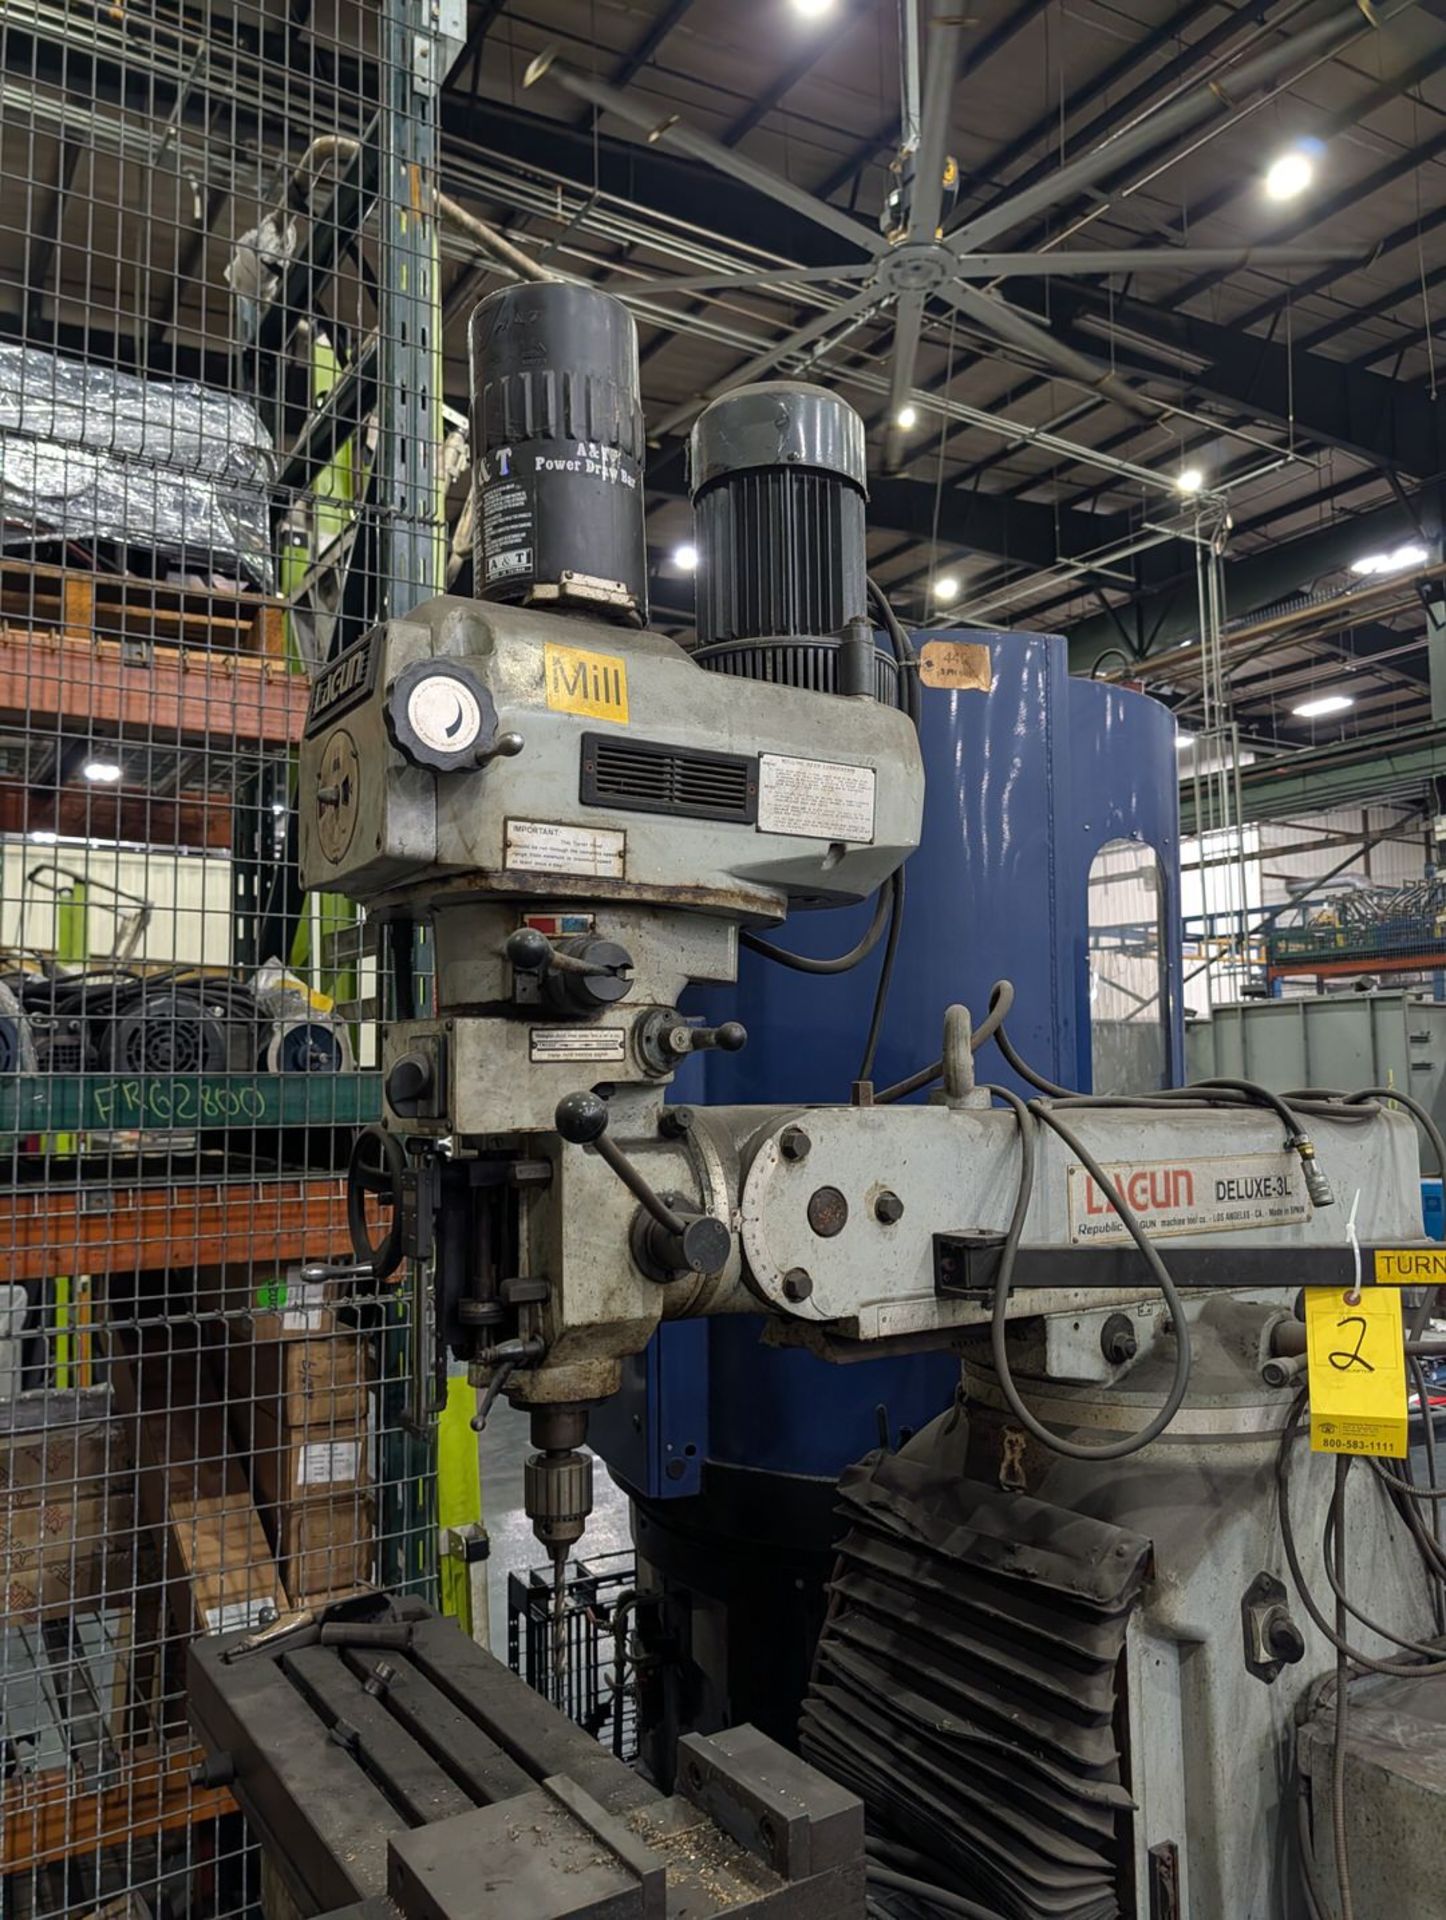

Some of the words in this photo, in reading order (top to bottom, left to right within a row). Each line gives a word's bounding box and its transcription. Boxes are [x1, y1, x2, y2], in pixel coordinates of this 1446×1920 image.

[495, 447, 512, 476] T
[535, 456, 582, 472] Power
[551, 656, 621, 706] Mill
[1216, 1175, 1292, 1201] DELUXE-3L
[1078, 1221, 1123, 1235] Republic
[1328, 1316, 1375, 1371] 2
[1322, 1437, 1395, 1452] 800-583-1111
